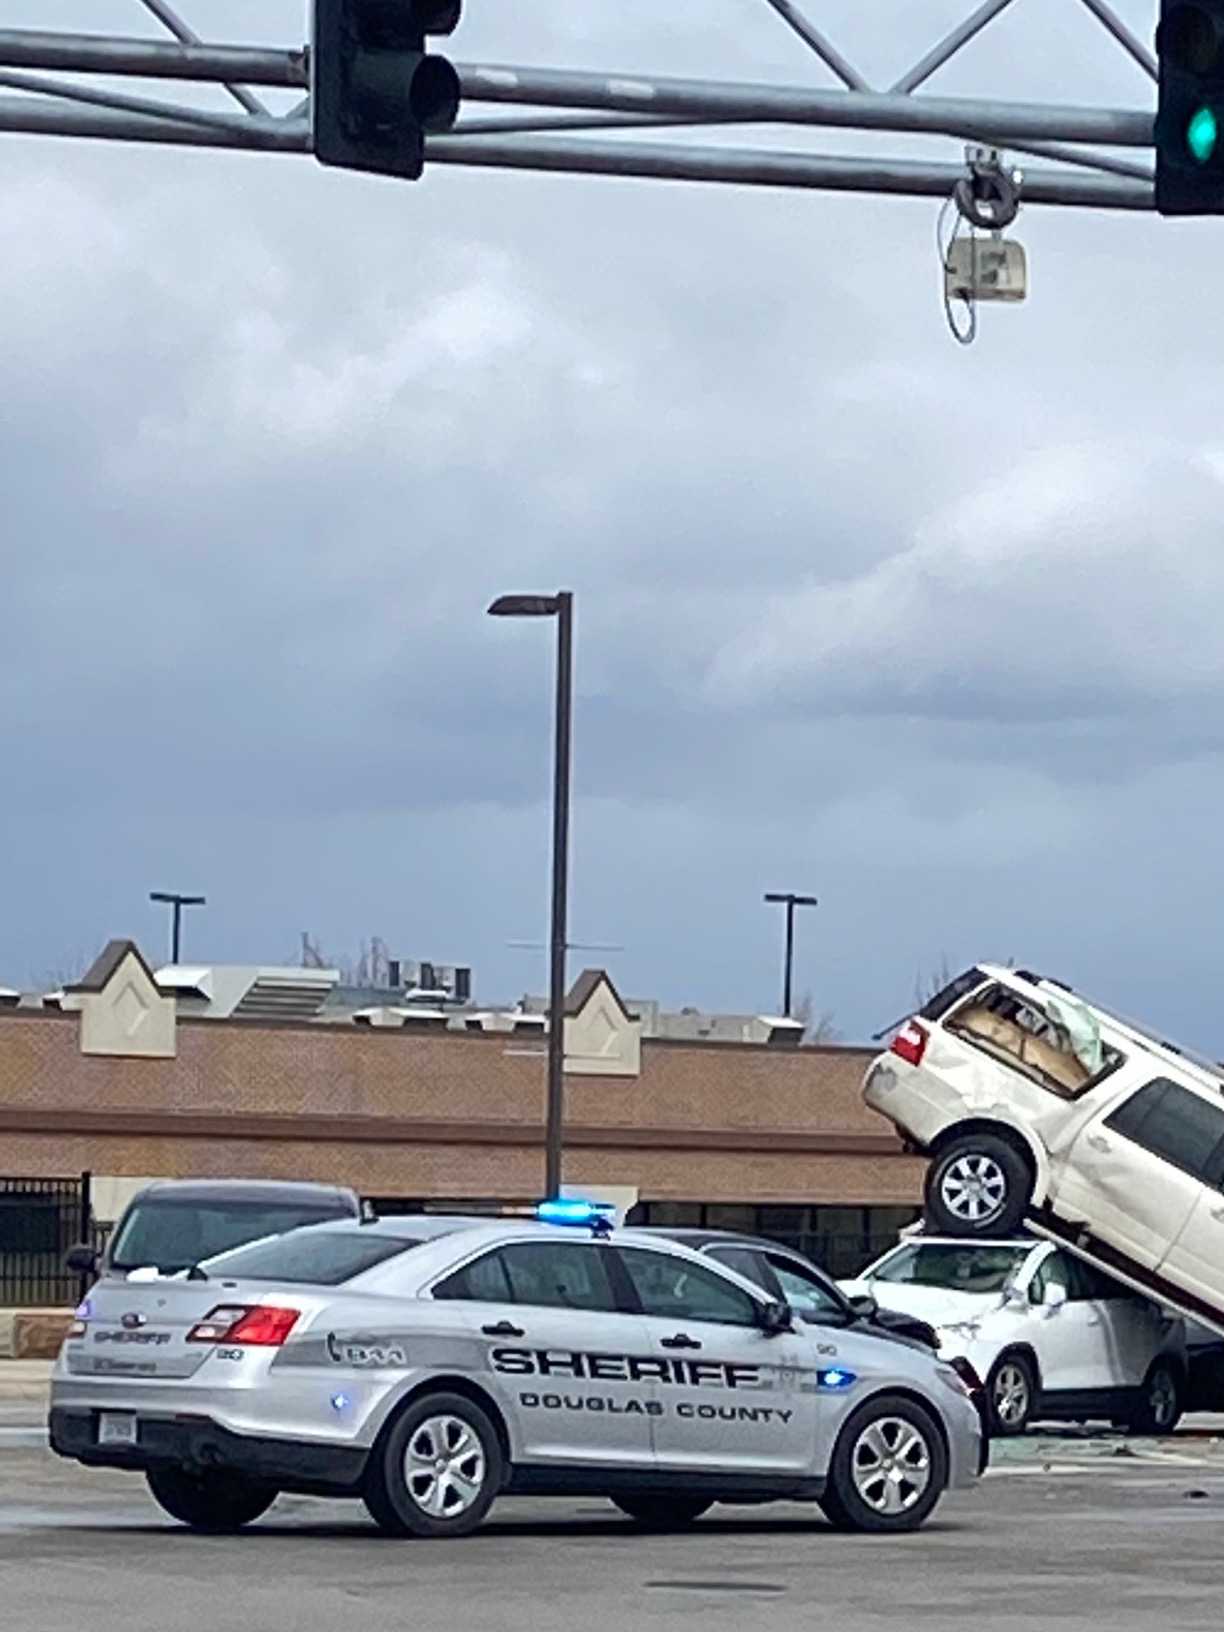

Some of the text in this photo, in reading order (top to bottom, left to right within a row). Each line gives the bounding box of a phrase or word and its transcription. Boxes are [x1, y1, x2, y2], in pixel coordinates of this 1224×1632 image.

[492, 1349, 760, 1388] SHERIFF
[519, 1392, 793, 1423] DOUGLAS COUNTY
